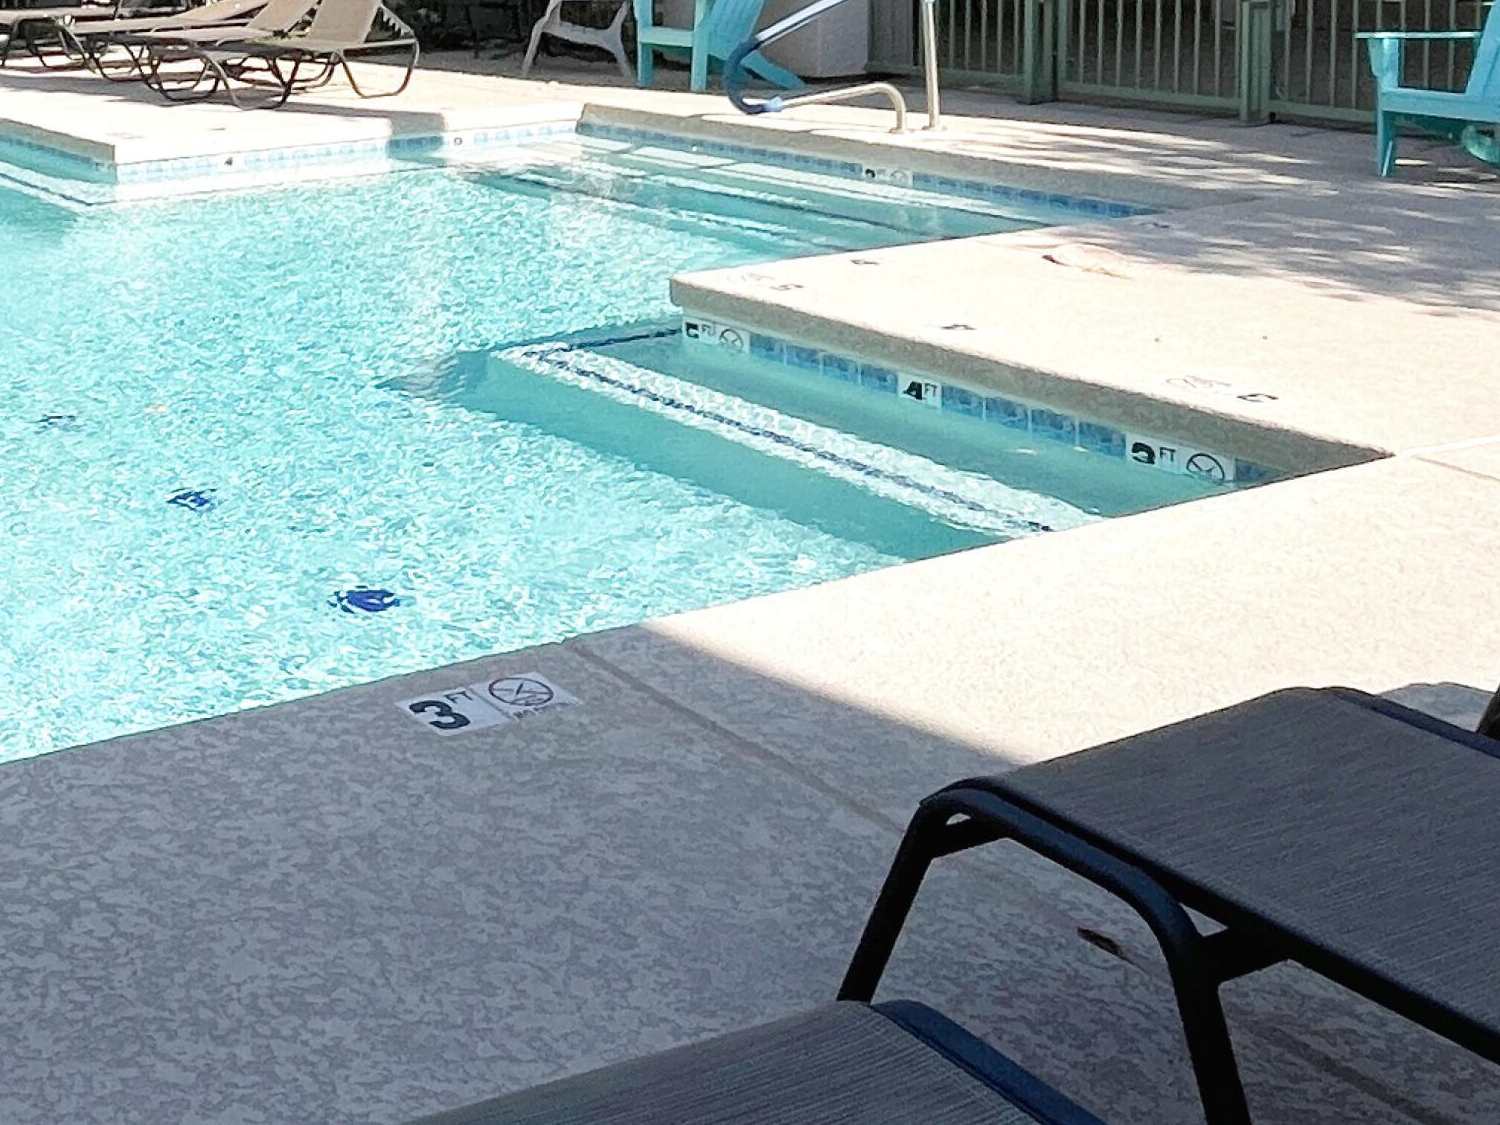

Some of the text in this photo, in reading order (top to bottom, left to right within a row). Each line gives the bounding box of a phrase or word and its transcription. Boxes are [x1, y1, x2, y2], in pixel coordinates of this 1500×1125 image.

[902, 380, 938, 401] 4 FT
[1159, 446, 1177, 463] FT
[409, 699, 471, 730] 3
